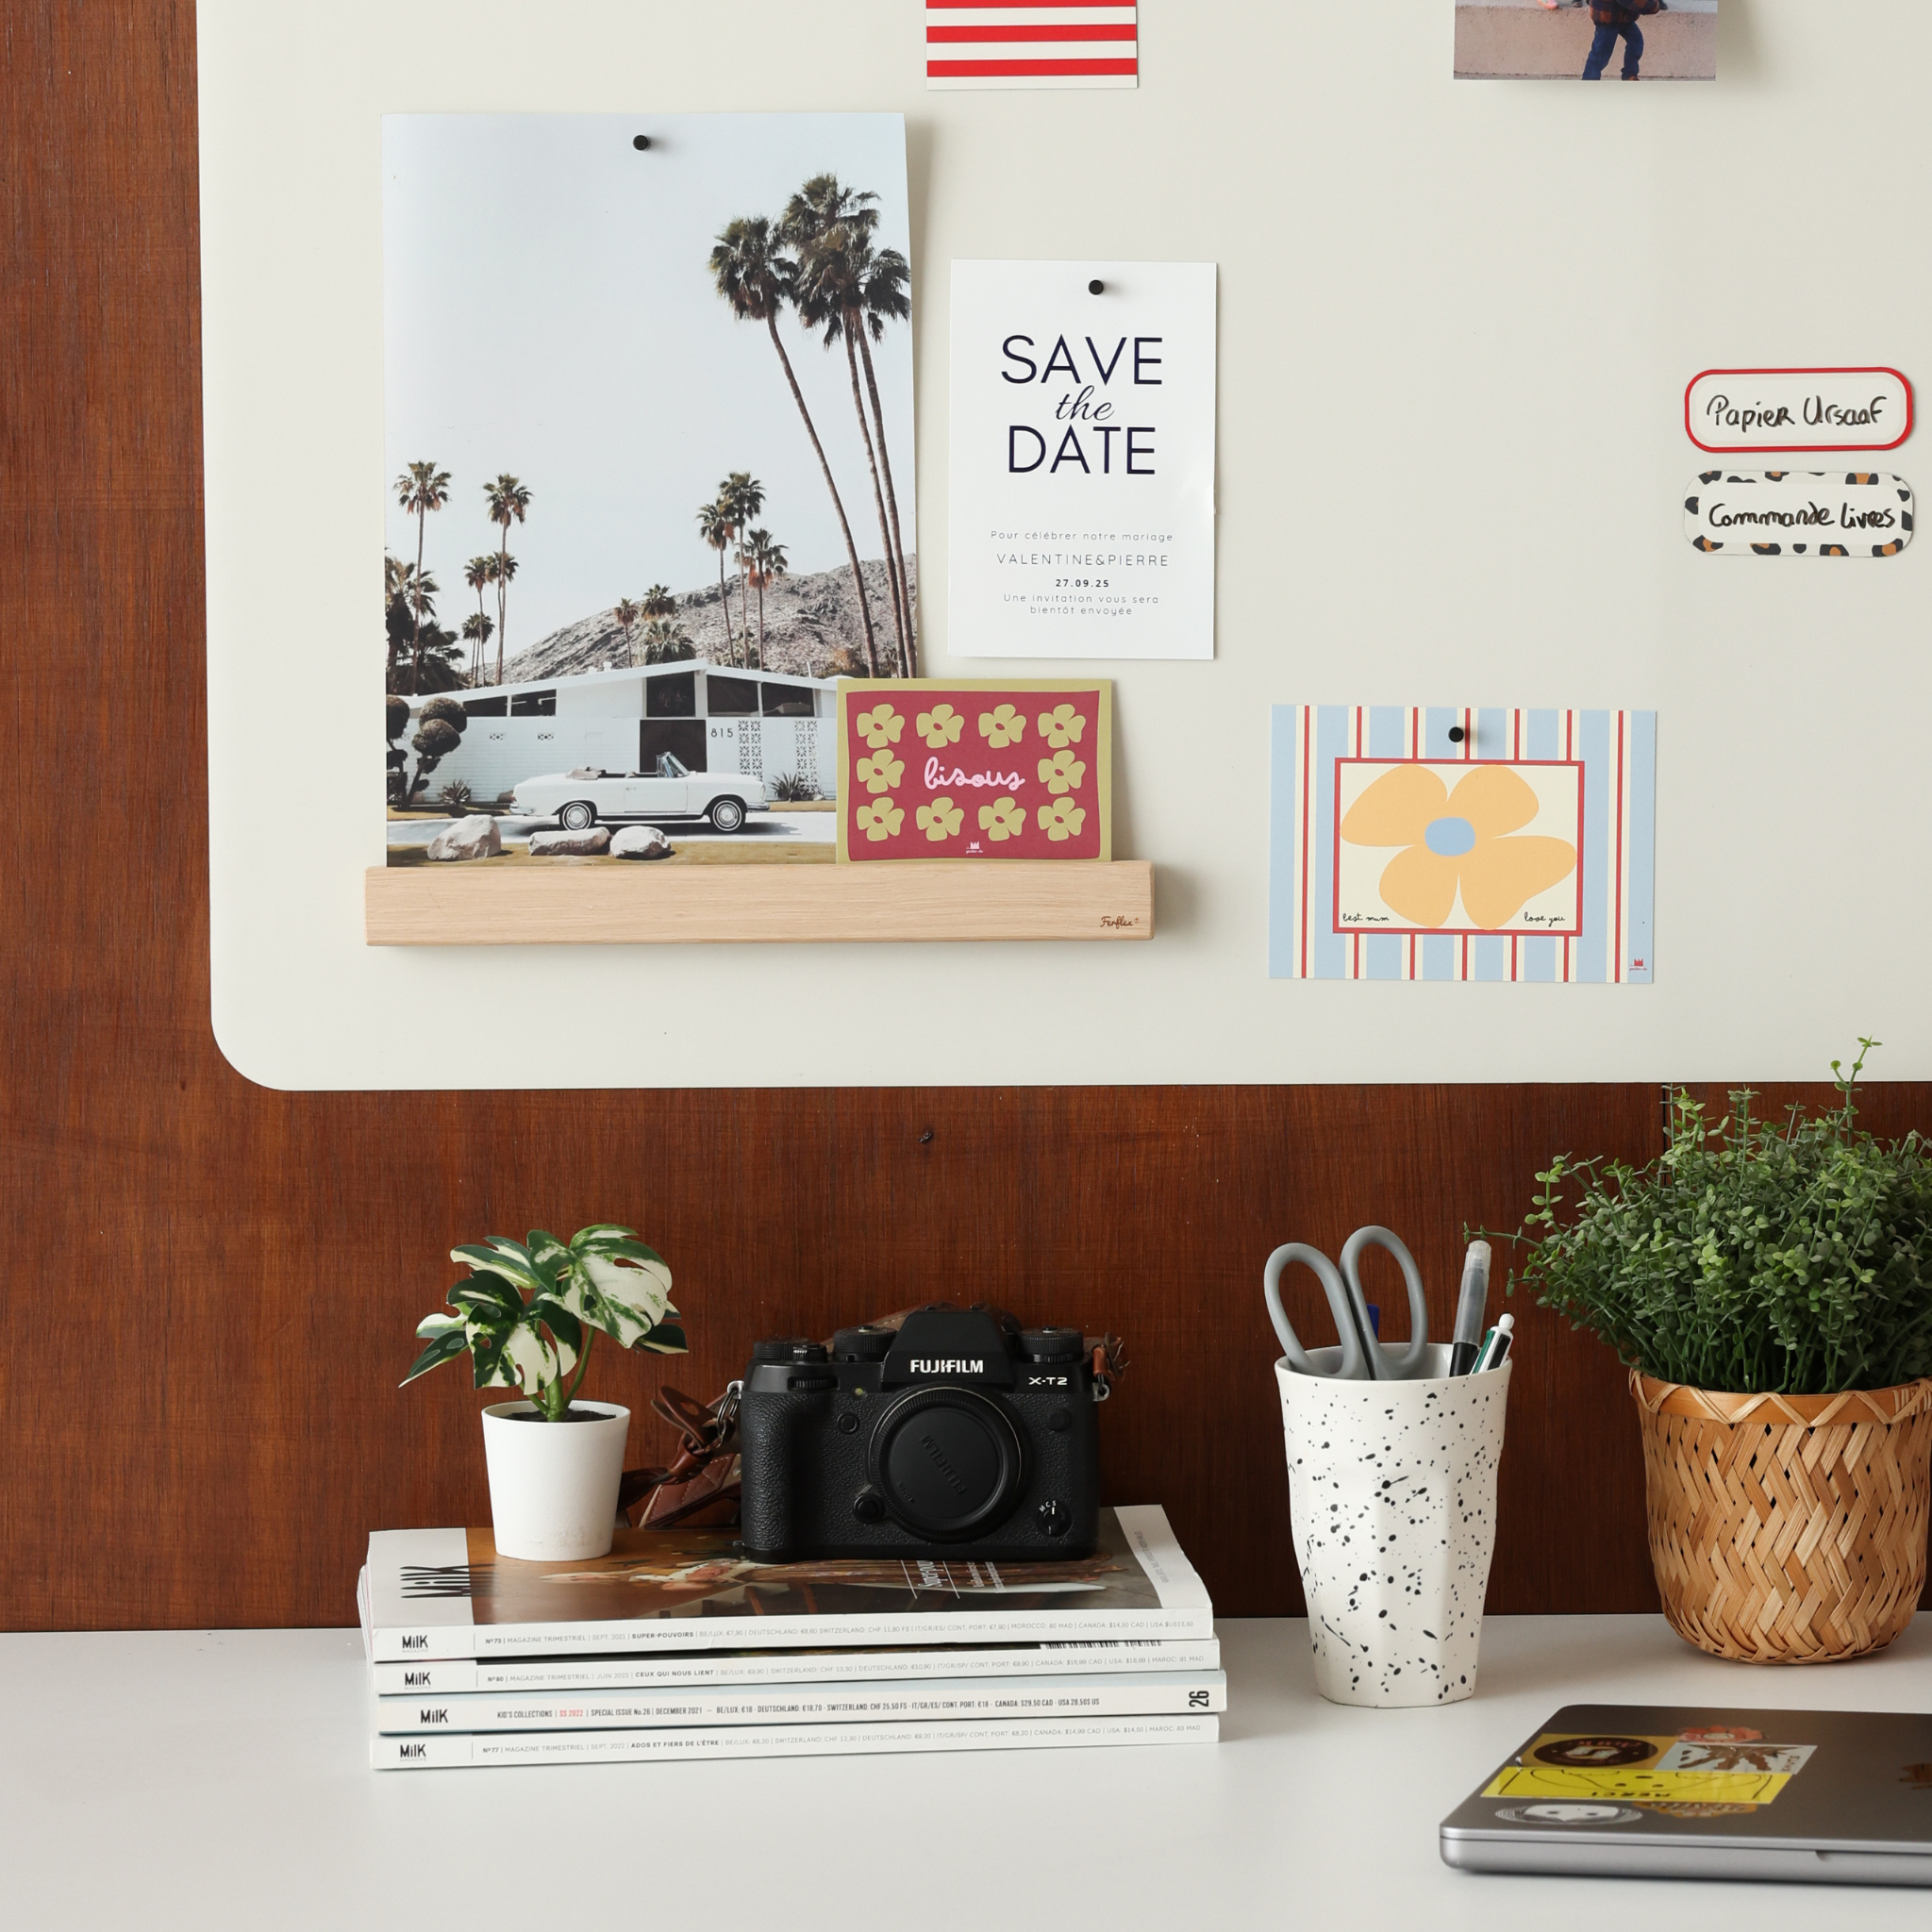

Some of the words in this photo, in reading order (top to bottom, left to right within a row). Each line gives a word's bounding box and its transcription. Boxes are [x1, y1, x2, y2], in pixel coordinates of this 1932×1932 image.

[1001, 334, 1163, 386] SAVE
[1055, 385, 1115, 421] the
[1707, 395, 1795, 432] Papier
[1009, 425, 1155, 475] DATE
[1709, 502, 1835, 527] Commande
[991, 530, 1019, 540] Pour
[1024, 531, 1077, 541] célébrer
[1083, 532, 1116, 541] notre
[1122, 534, 1173, 543] mariage
[997, 554, 1167, 566] VALENTINE&PIERRE
[1055, 578, 1109, 588] 27.09.25
[1004, 593, 1026, 603] Une
[1032, 594, 1092, 603] invitation
[1030, 606, 1074, 615] bientôt
[1080, 607, 1132, 617] envoyée
[710, 727, 734, 739] 815
[924, 757, 1025, 791] bisous
[1099, 915, 1134, 930] Ferflex
[1342, 912, 1364, 923] best
[1524, 911, 1547, 923] love
[1548, 916, 1566, 928] you
[910, 1360, 983, 1373] FUJIFILM
[921, 1434, 968, 1495] FUJIFILM
[402, 1634, 428, 1649] MilK
[632, 1631, 694, 1640] SUPER-POUVOIRS
[405, 1672, 431, 1686] MilK
[1189, 1690, 1209, 1707] 26
[420, 1708, 448, 1724] MilK
[514, 1710, 553, 1719] COLLECTIONS
[559, 1709, 568, 1718] SS
[569, 1709, 583, 1718] 2022
[688, 1707, 703, 1715] 2021
[716, 1706, 741, 1714] BE/LUX:
[741, 1706, 753, 1714] €18
[758, 1705, 801, 1713] DEUTSCHLAND:
[827, 1703, 870, 1712] SWITZERLAND:
[900, 1702, 908, 1710] FS
[942, 1701, 959, 1709] CONT.
[995, 1700, 1018, 1708] CANADA:
[1058, 1698, 1070, 1707] USA
[400, 1743, 426, 1758] MilK
